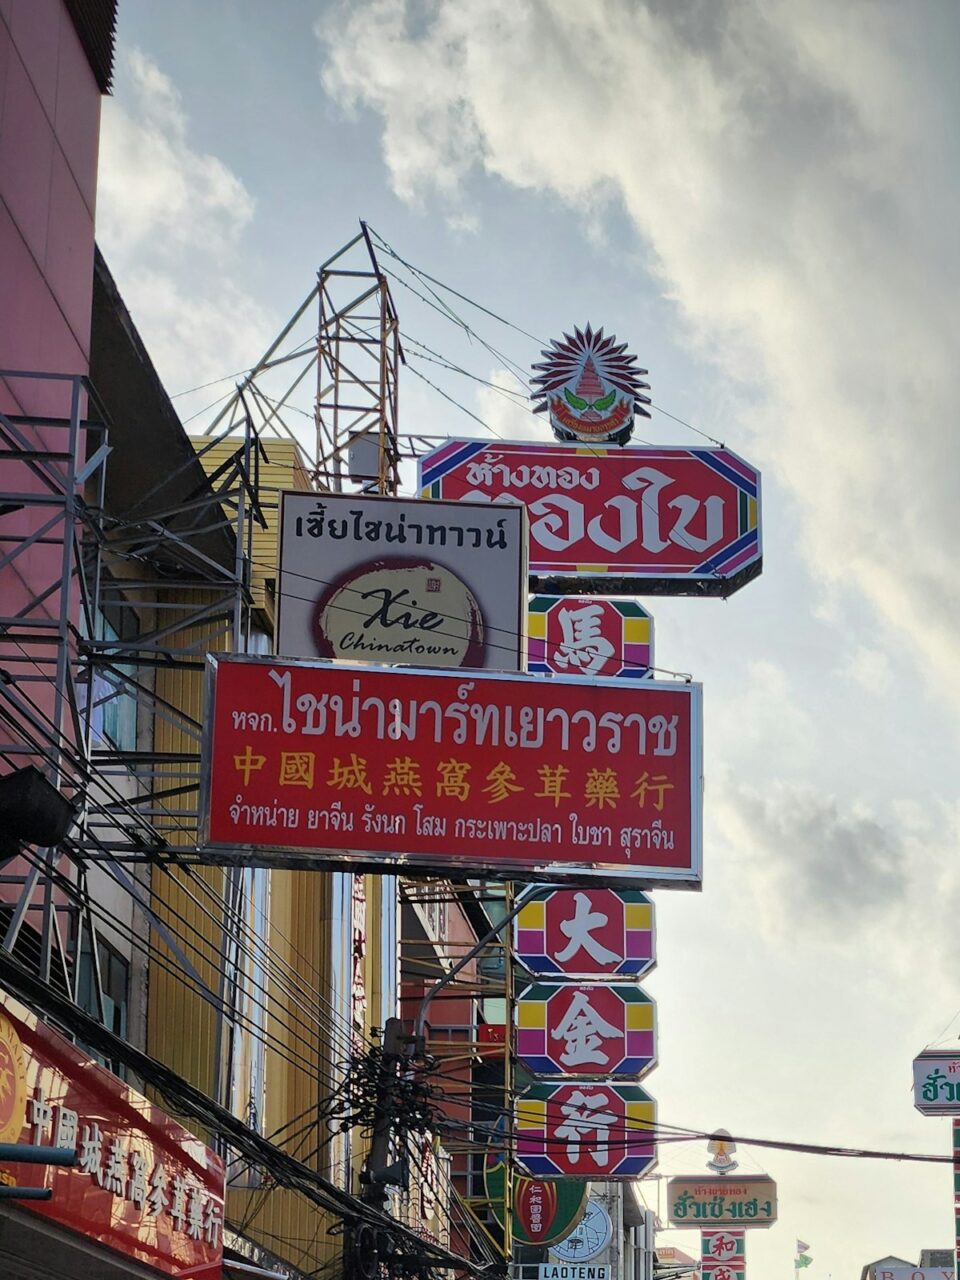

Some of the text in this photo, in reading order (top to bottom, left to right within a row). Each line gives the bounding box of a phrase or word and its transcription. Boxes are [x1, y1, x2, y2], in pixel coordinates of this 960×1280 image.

[466, 455, 600, 490] ห้างทอง
[461, 466, 727, 554] องใบ
[361, 588, 445, 631] Xie
[339, 631, 459, 656] Chinatown
[553, 604, 616, 675] 馬
[268, 668, 679, 757] ไชน่ามาร์ทเยาวราช
[229, 795, 674, 859] จำหน่าย ยาจีน รังนก โสม กระเพาะปลา ใบชา สุราจีน
[543, 1266, 606, 1279] LAOTENG
